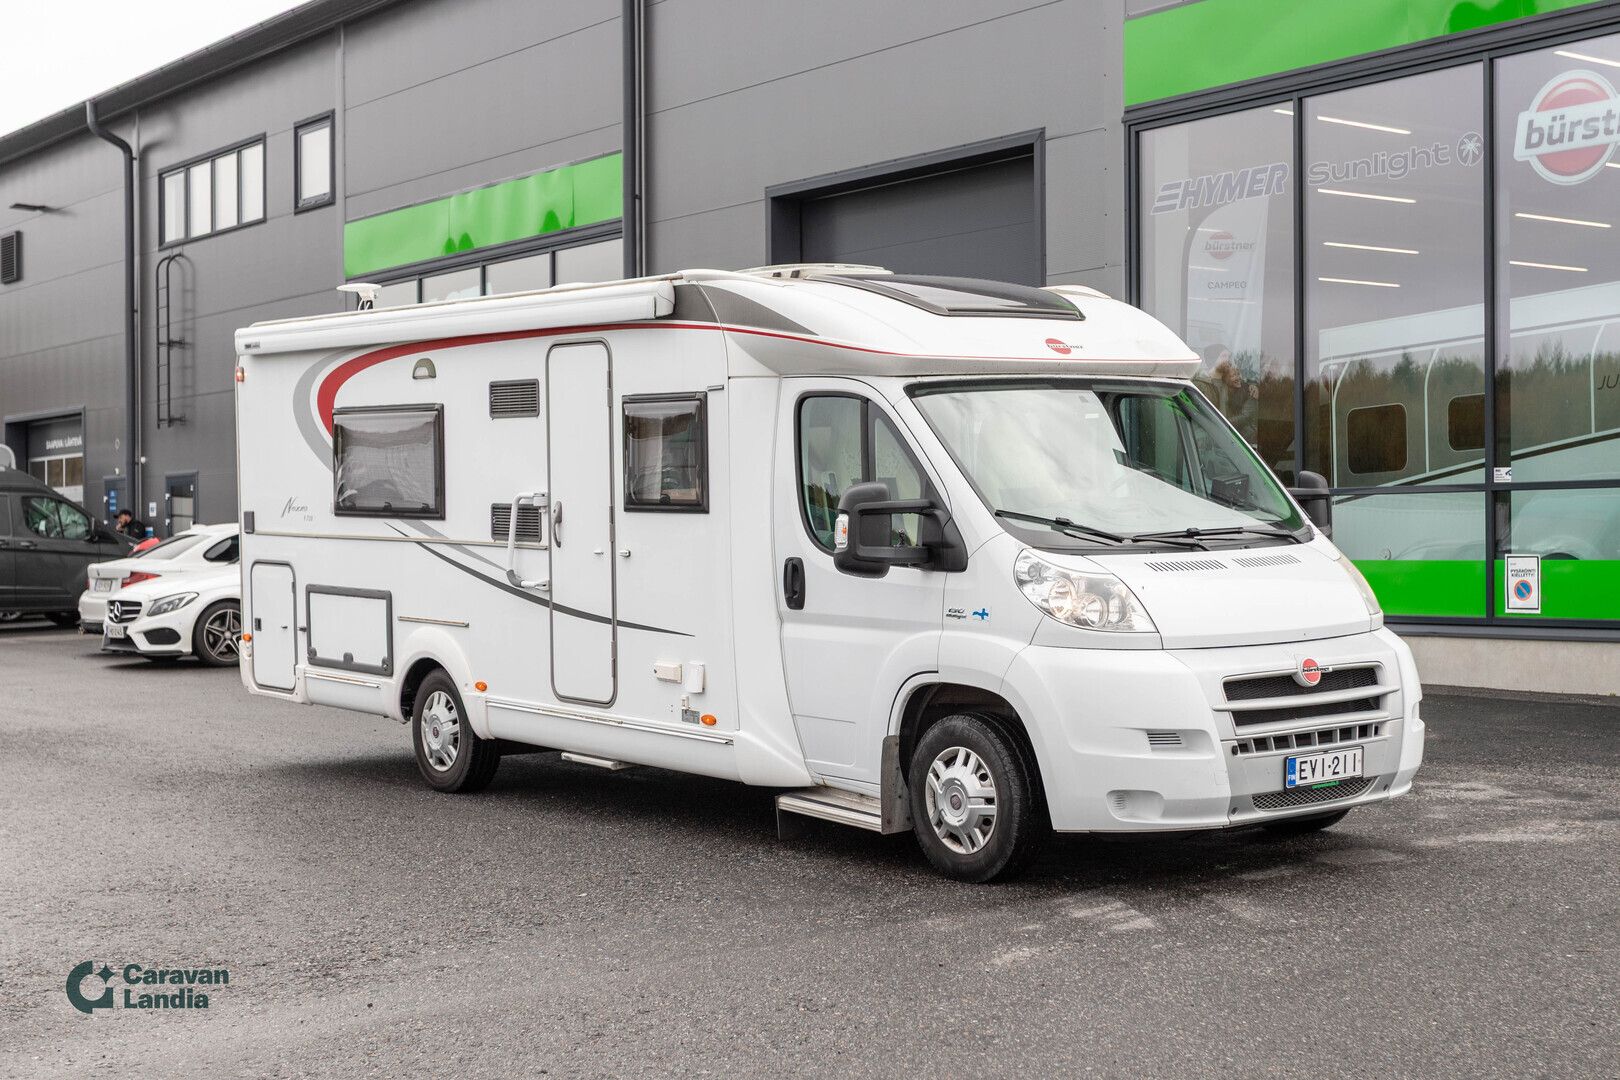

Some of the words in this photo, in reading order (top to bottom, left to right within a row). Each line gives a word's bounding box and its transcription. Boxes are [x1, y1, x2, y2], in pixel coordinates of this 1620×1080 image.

[1524, 109, 1620, 150] bürst
[1307, 142, 1450, 186] Sunlight
[1178, 162, 1289, 210] HYMER
[1204, 239, 1256, 251] bürstner
[1299, 752, 1356, 781] EVI-211
